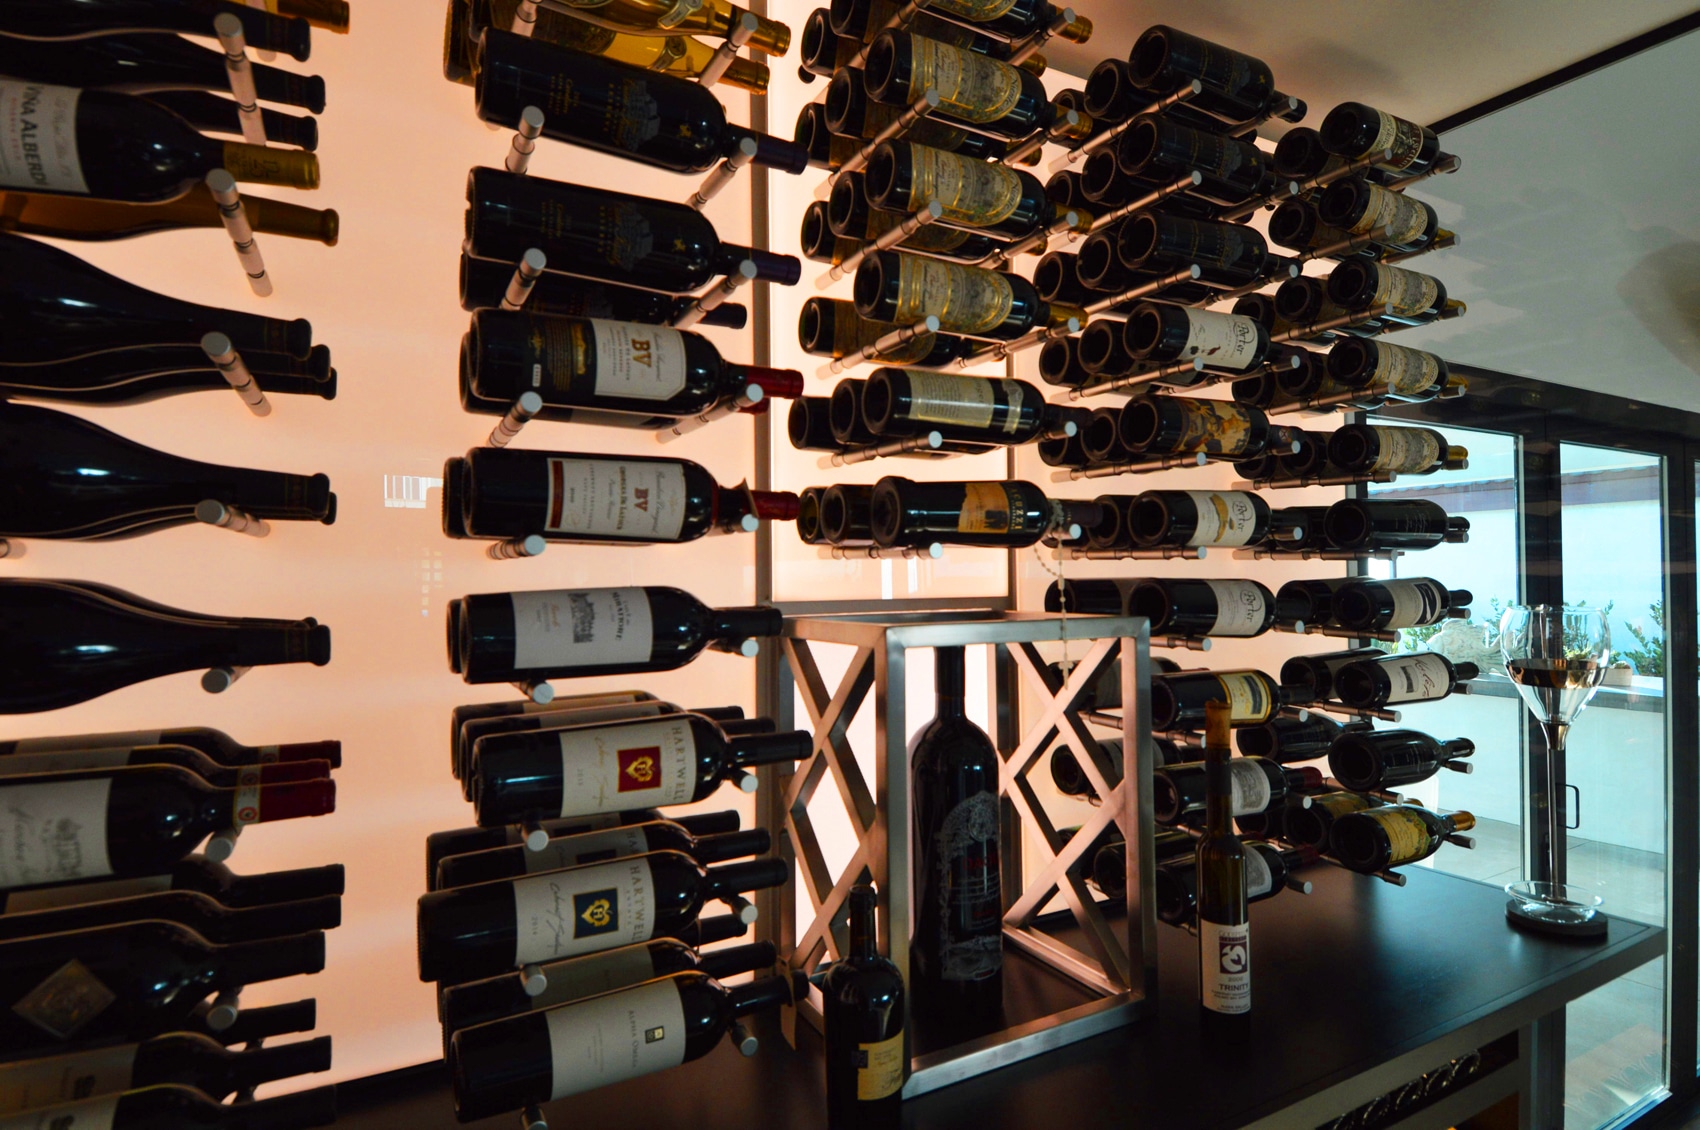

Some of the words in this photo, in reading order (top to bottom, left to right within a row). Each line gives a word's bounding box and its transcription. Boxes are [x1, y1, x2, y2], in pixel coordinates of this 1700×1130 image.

[21, 118, 49, 186] ALBERDI
[631, 338, 652, 368] BV
[1235, 322, 1253, 356] Porter
[634, 488, 649, 512] BV
[671, 726, 686, 801] HARTWELL
[630, 866, 645, 941] HARTWELL
[1218, 983, 1248, 991] TRINITY
